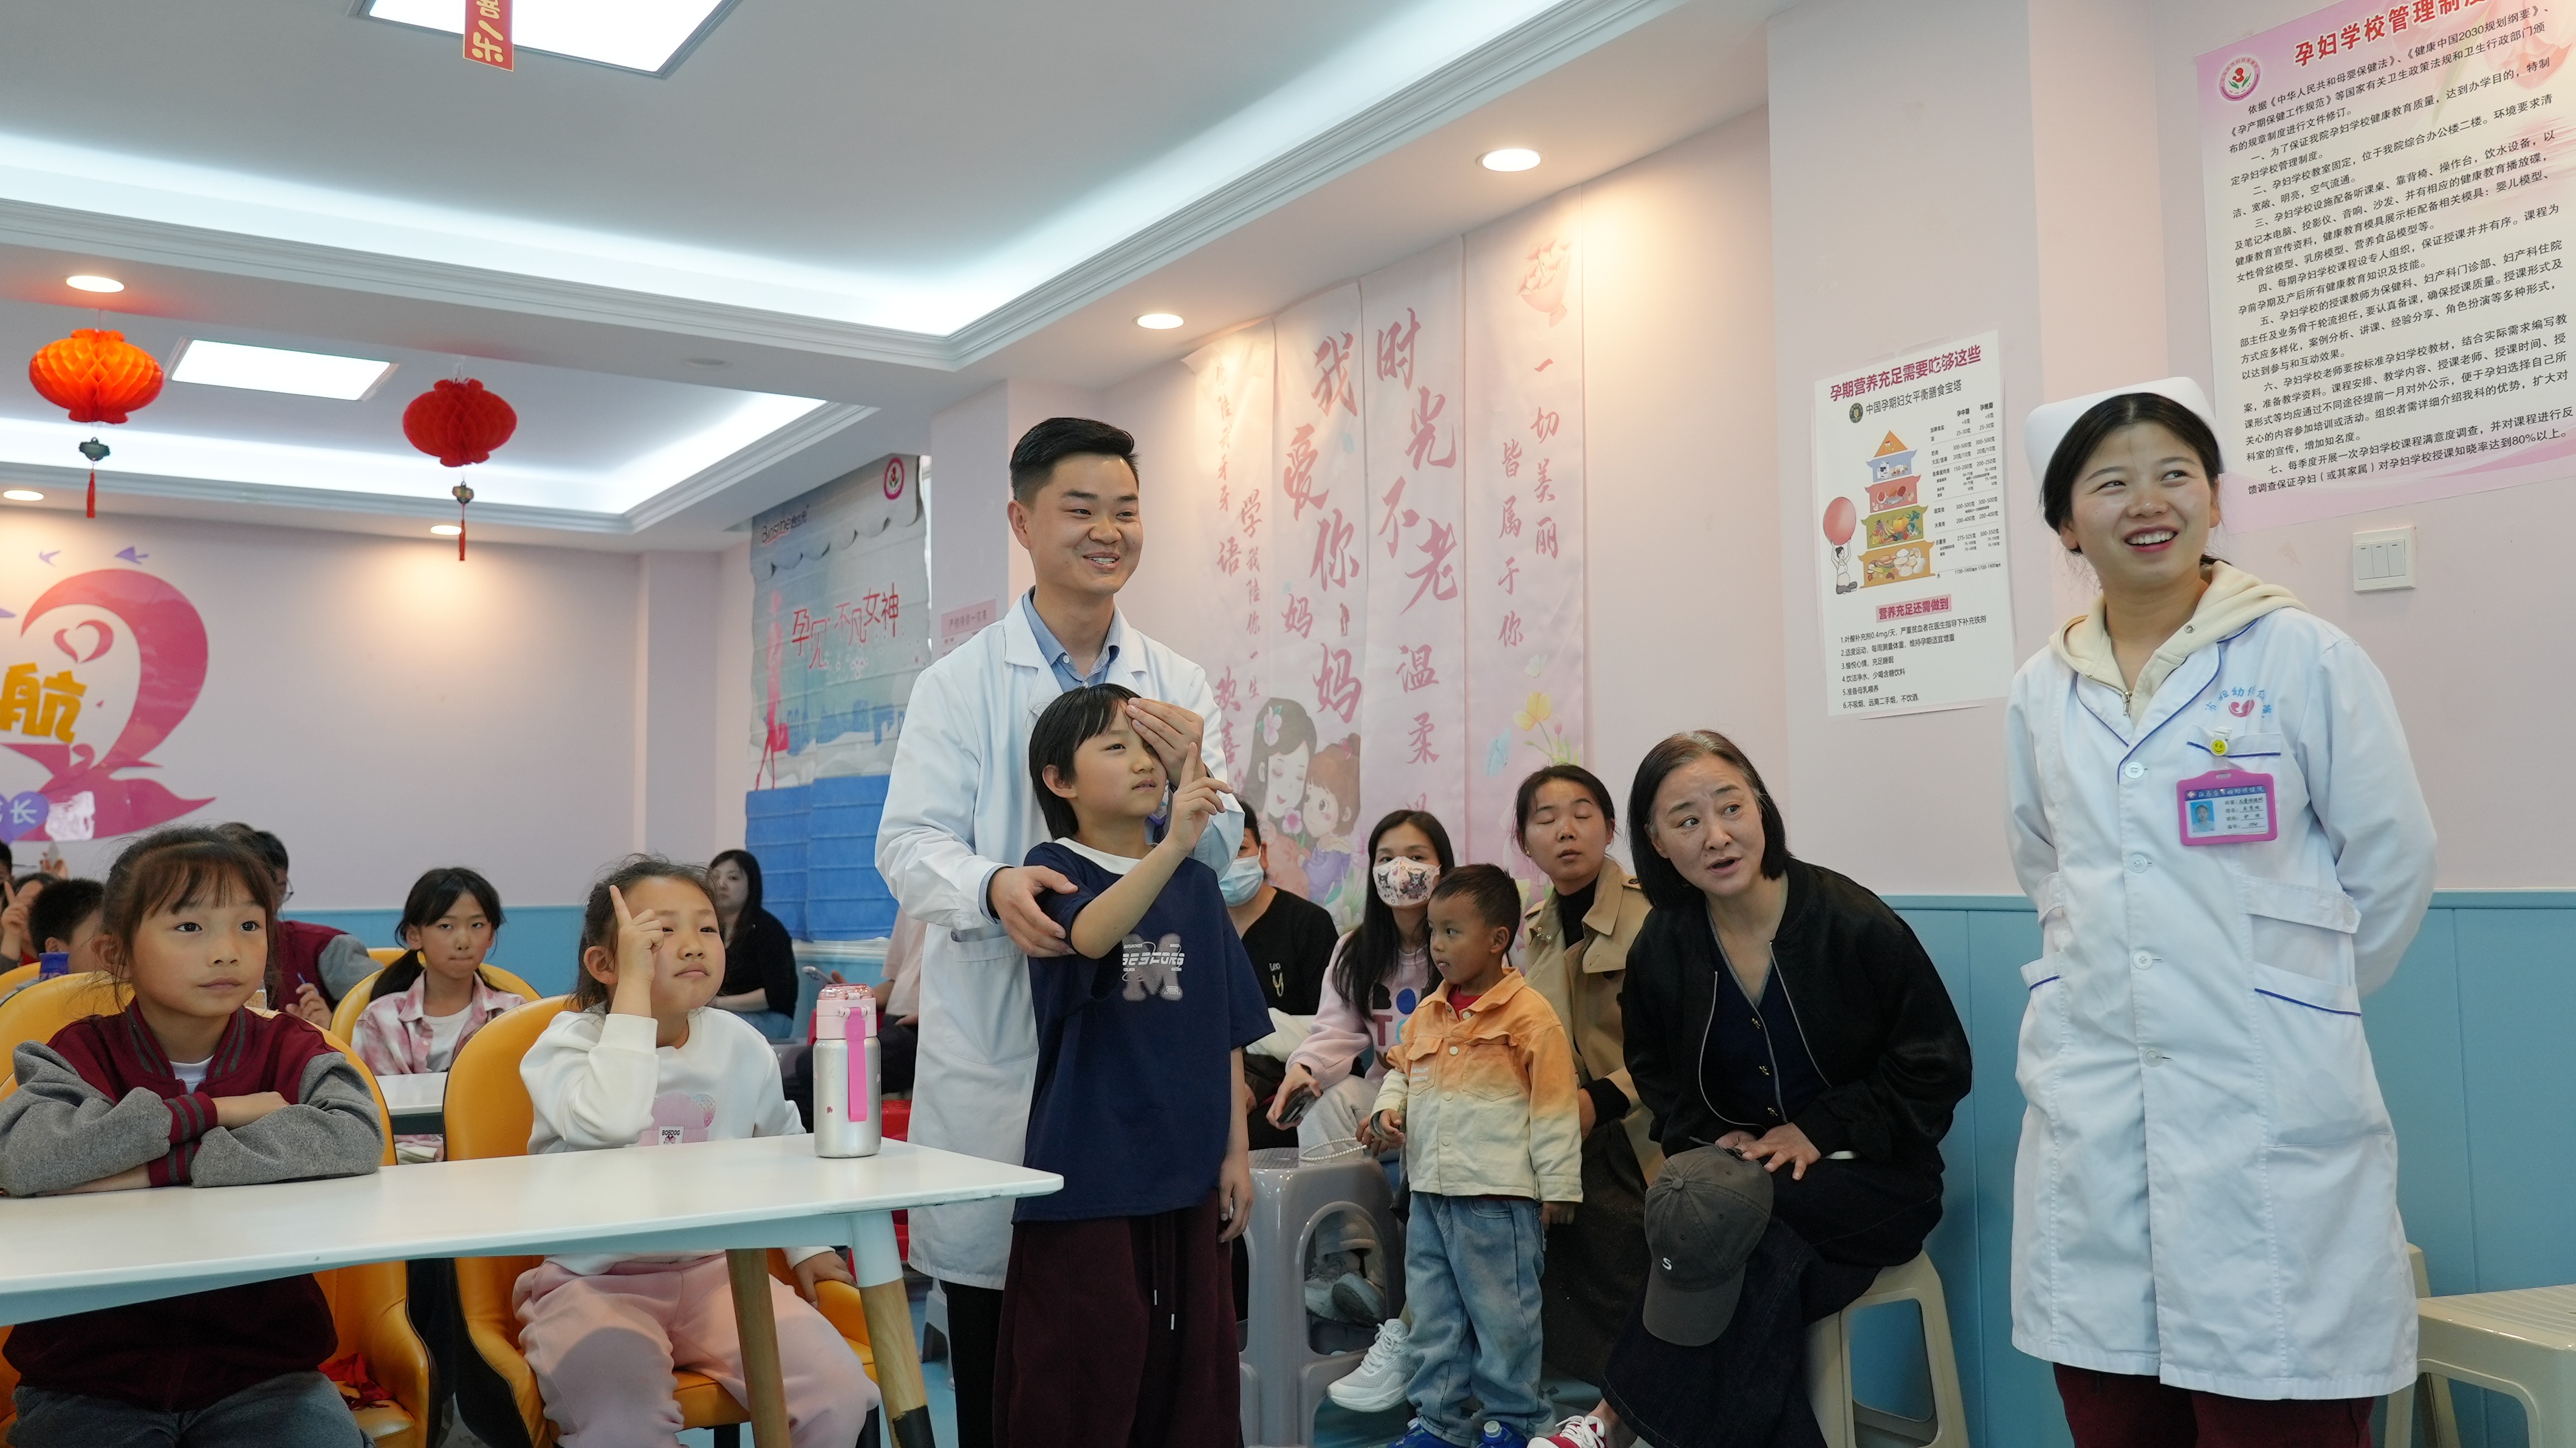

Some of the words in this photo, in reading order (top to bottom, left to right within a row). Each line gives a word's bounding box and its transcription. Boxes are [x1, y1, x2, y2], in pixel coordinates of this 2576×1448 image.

[2230, 107, 2351, 153] 布的规章制度进行文件修订。
[2231, 151, 2323, 186] 定孕妇学校管理制度。
[2233, 174, 2355, 219] 洁、宽敞、明亮，空气流通。
[2236, 221, 2434, 283] 女性骨盆模型、乳房模型、营养食品模型等。
[2238, 259, 2425, 315] 孕前孕期及产后所有健康教育知识及技能。
[1830, 344, 1981, 401] 孕期营养充足需要吃够这些
[2242, 349, 2345, 380] 以达到参与和互动效果。
[1866, 379, 1962, 415] 中国孕期妇女平衡膳食宝塔
[2247, 432, 2360, 462] 科室的宣传，增加知名度。
[1498, 438, 1524, 647] 皆属于你
[1879, 597, 1948, 620] 营养充足还需做到
[1396, 644, 1439, 811] 温柔
[1662, 1257, 1672, 1270] S
